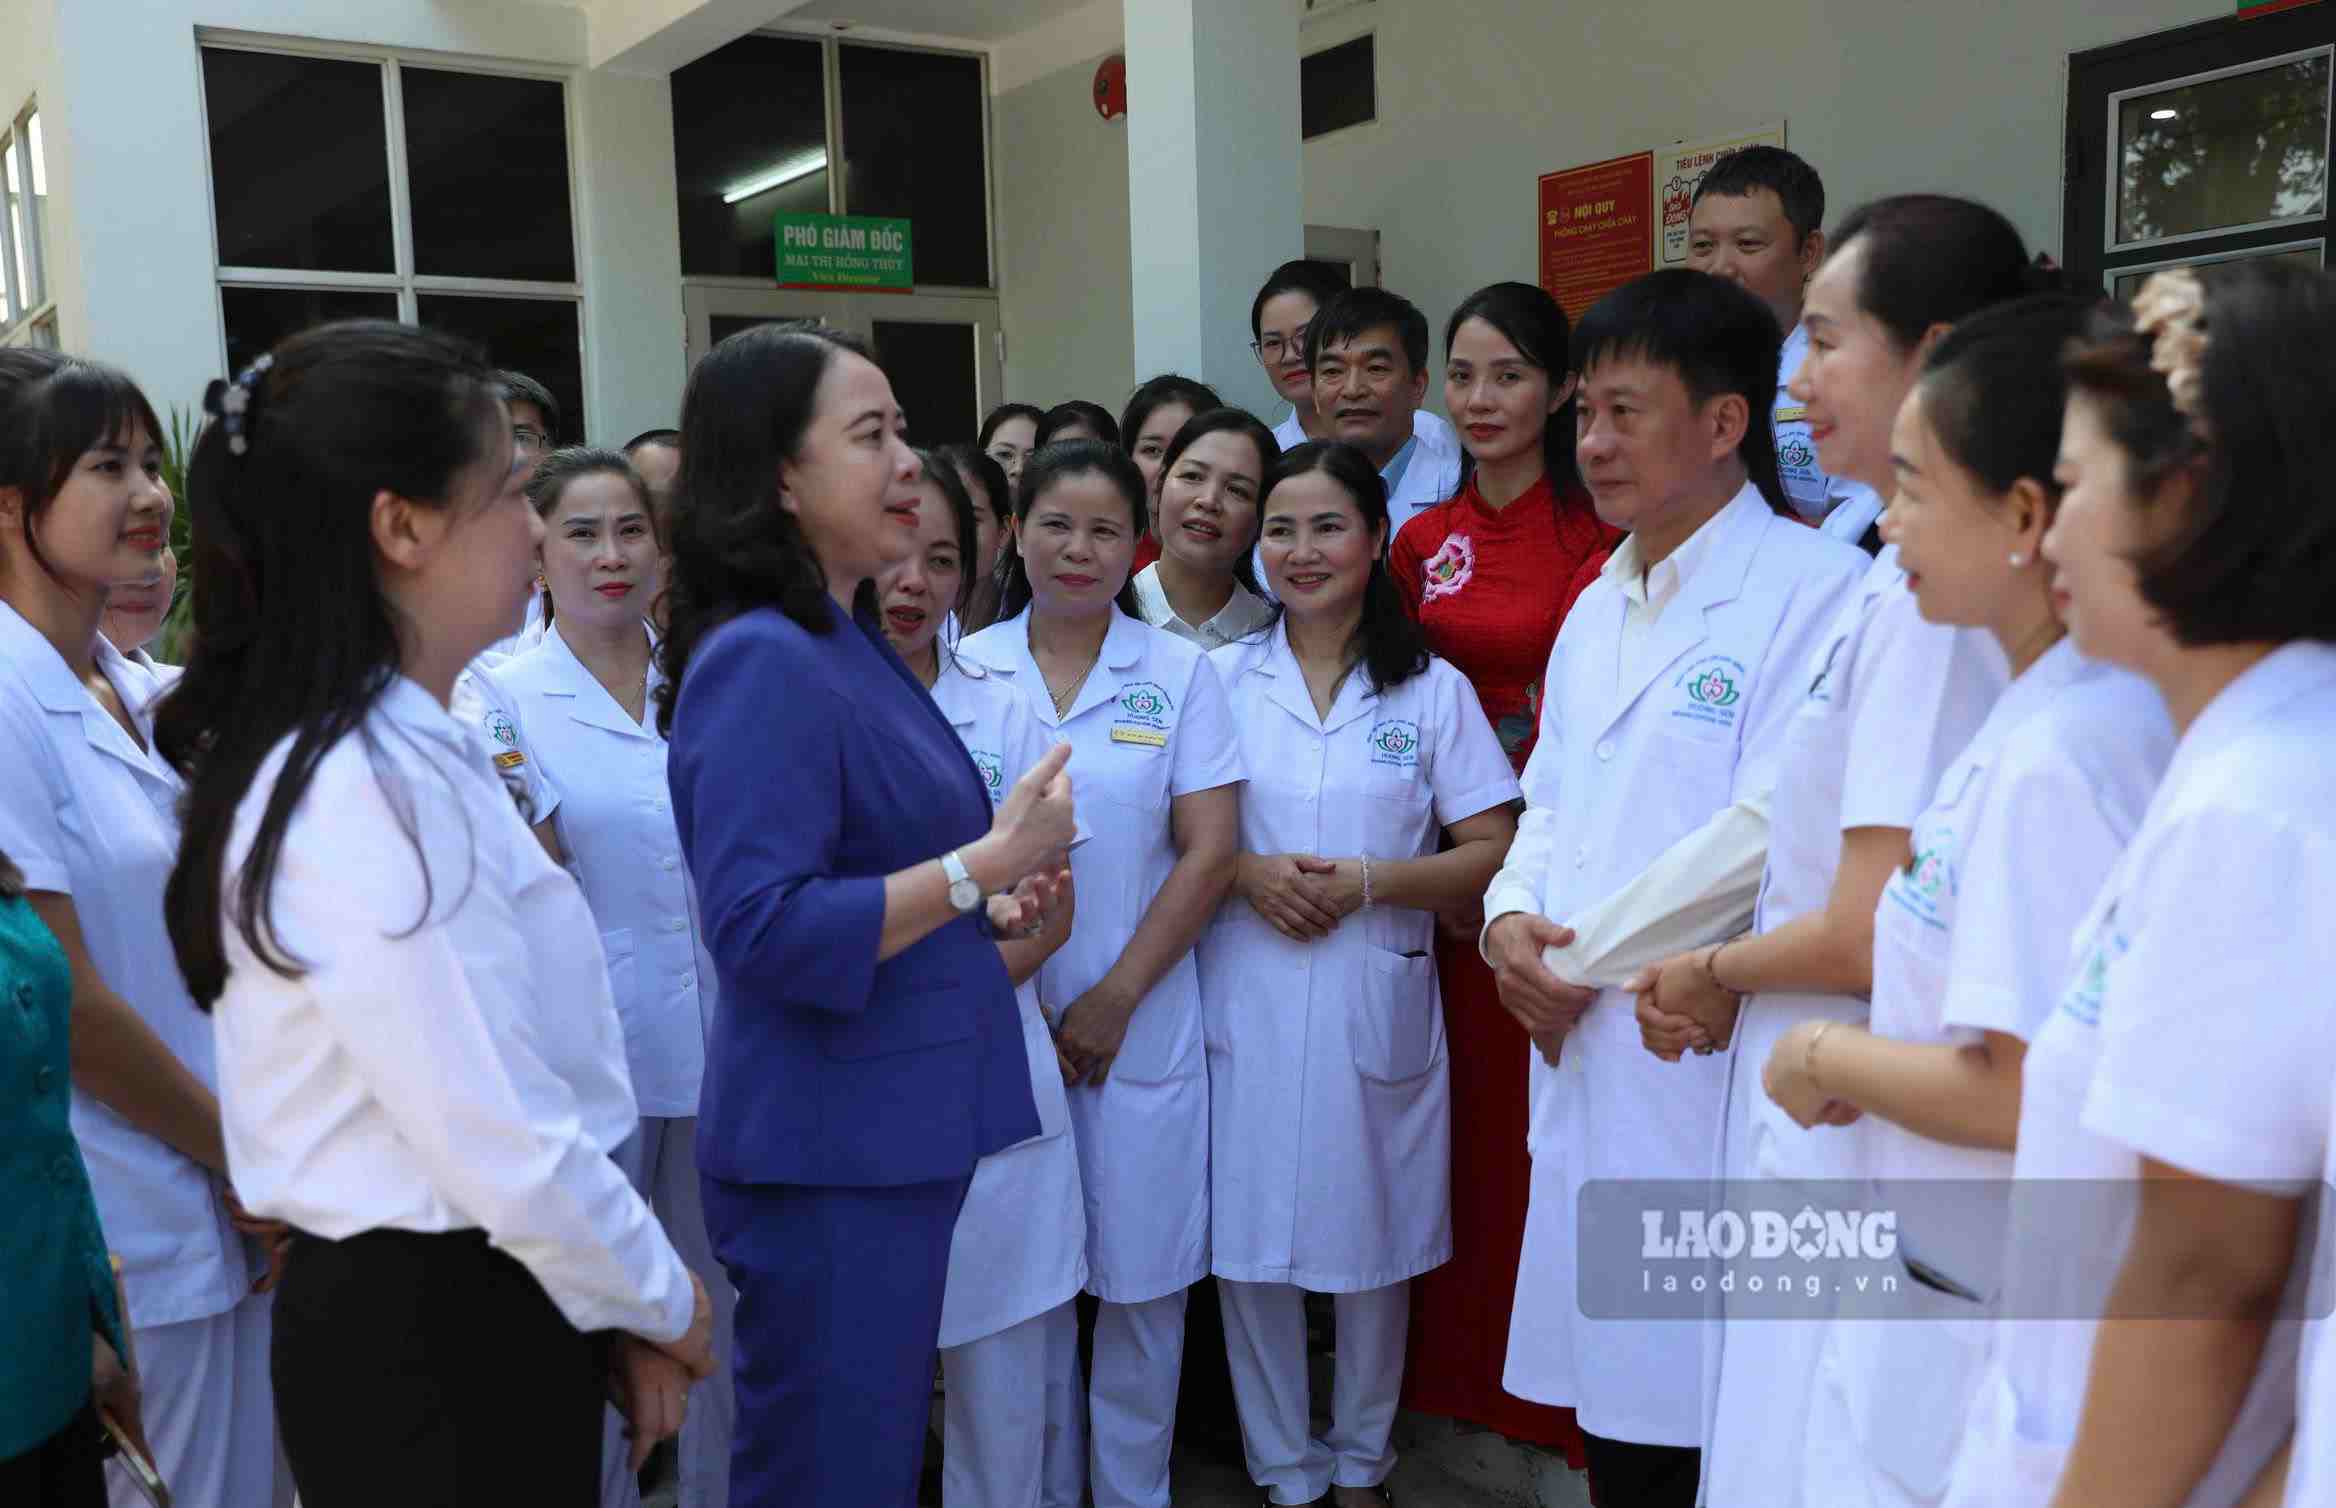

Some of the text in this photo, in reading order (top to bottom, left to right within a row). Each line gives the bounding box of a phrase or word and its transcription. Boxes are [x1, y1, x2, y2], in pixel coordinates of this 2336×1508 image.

[783, 222, 904, 253] PHÓ GIÁM ĐỐC
[784, 253, 808, 267] MAI
